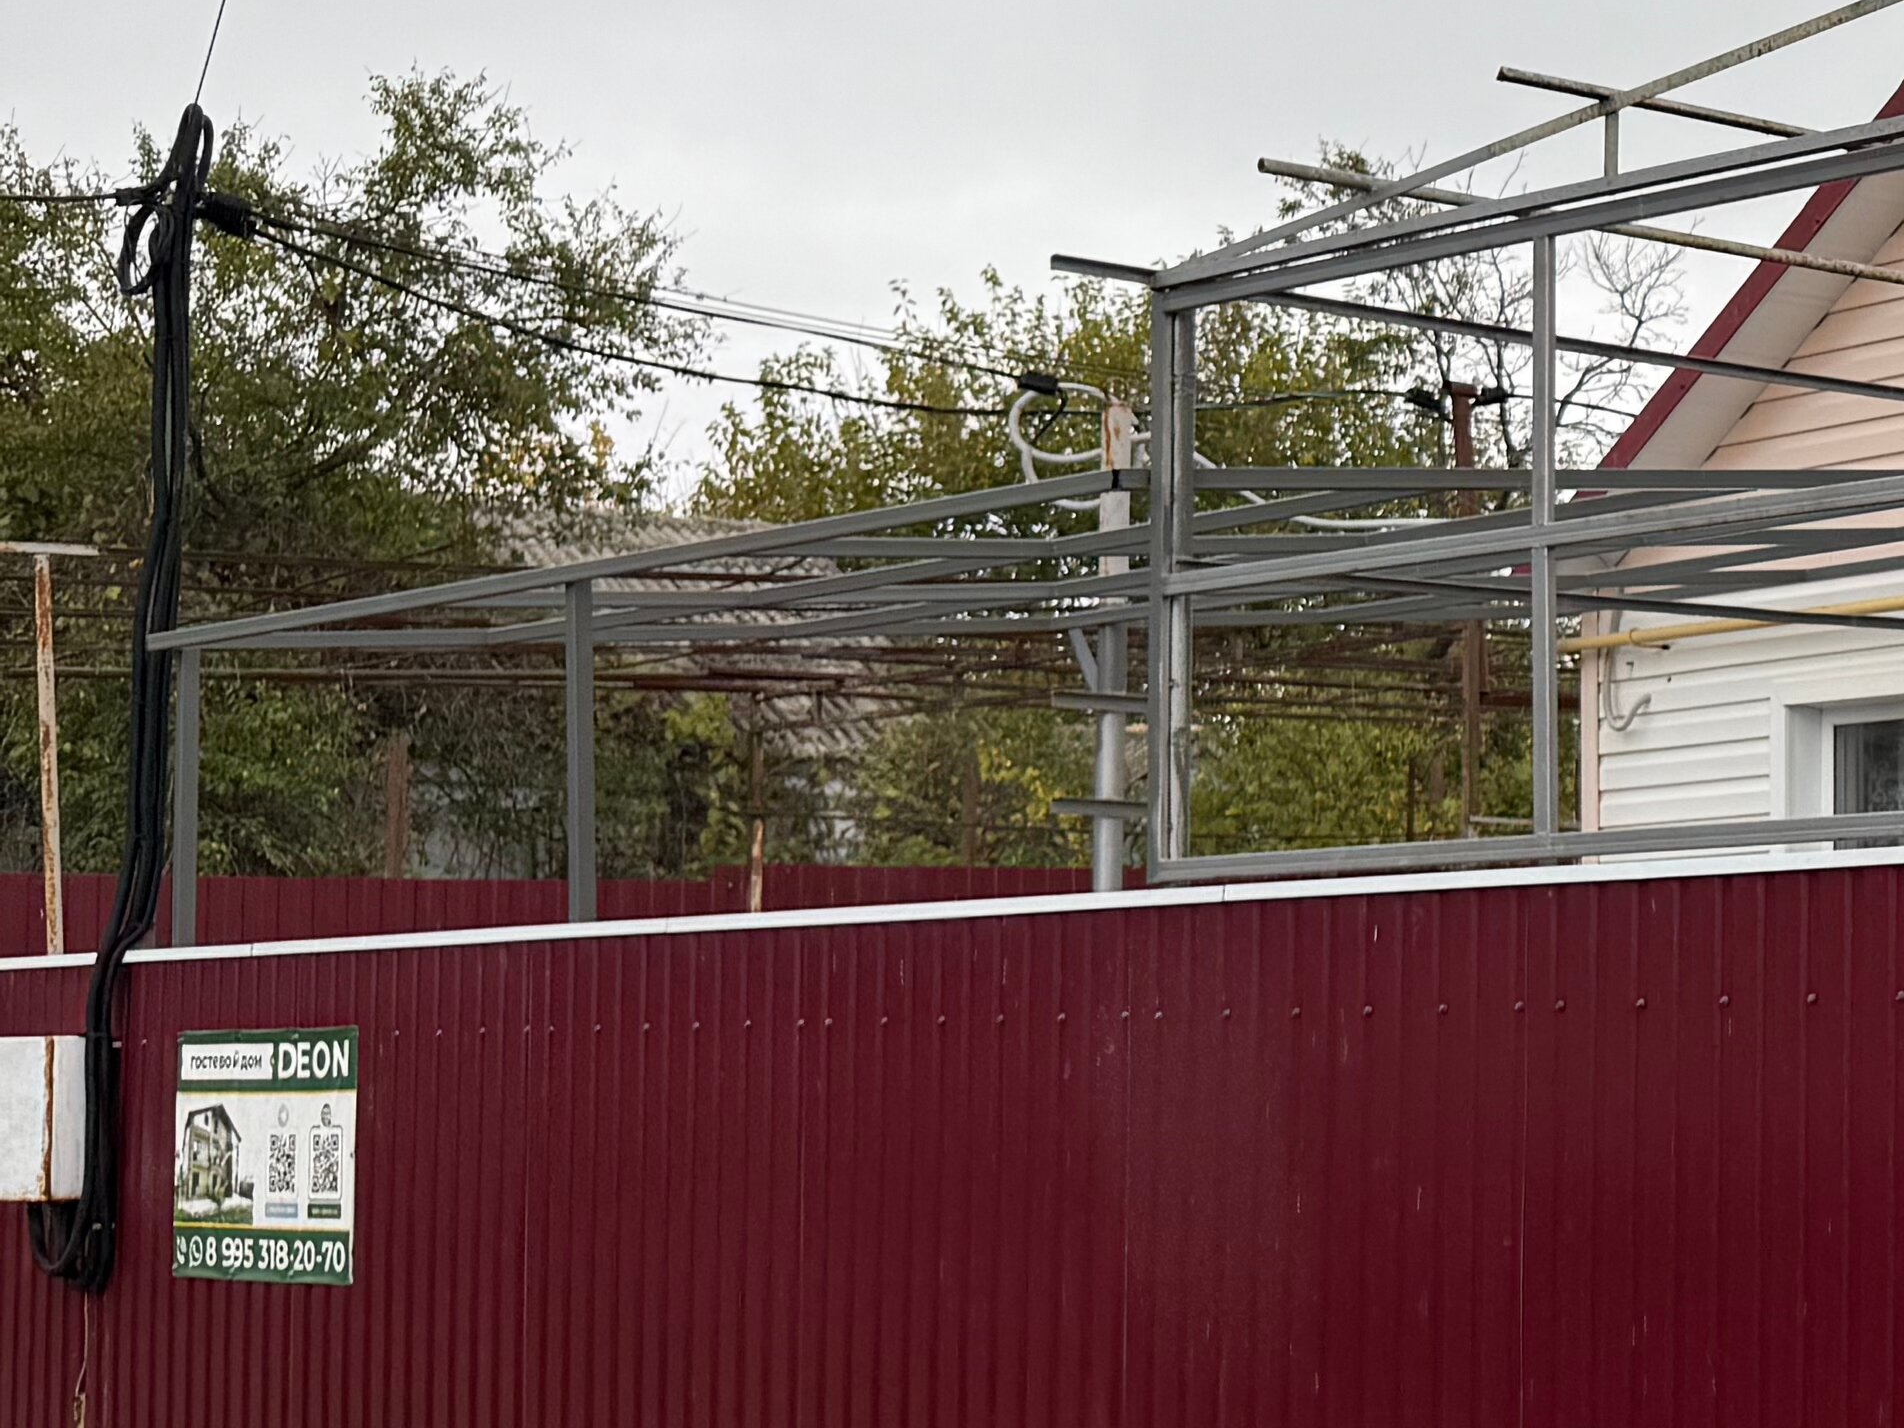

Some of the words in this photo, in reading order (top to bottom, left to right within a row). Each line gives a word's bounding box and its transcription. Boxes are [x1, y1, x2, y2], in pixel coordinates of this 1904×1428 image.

[240, 1054, 262, 1071] дом
[277, 1039, 350, 1079] DEON
[205, 1236, 217, 1267] 8
[222, 1236, 254, 1269] 995
[258, 1239, 346, 1273] 318-20-70
